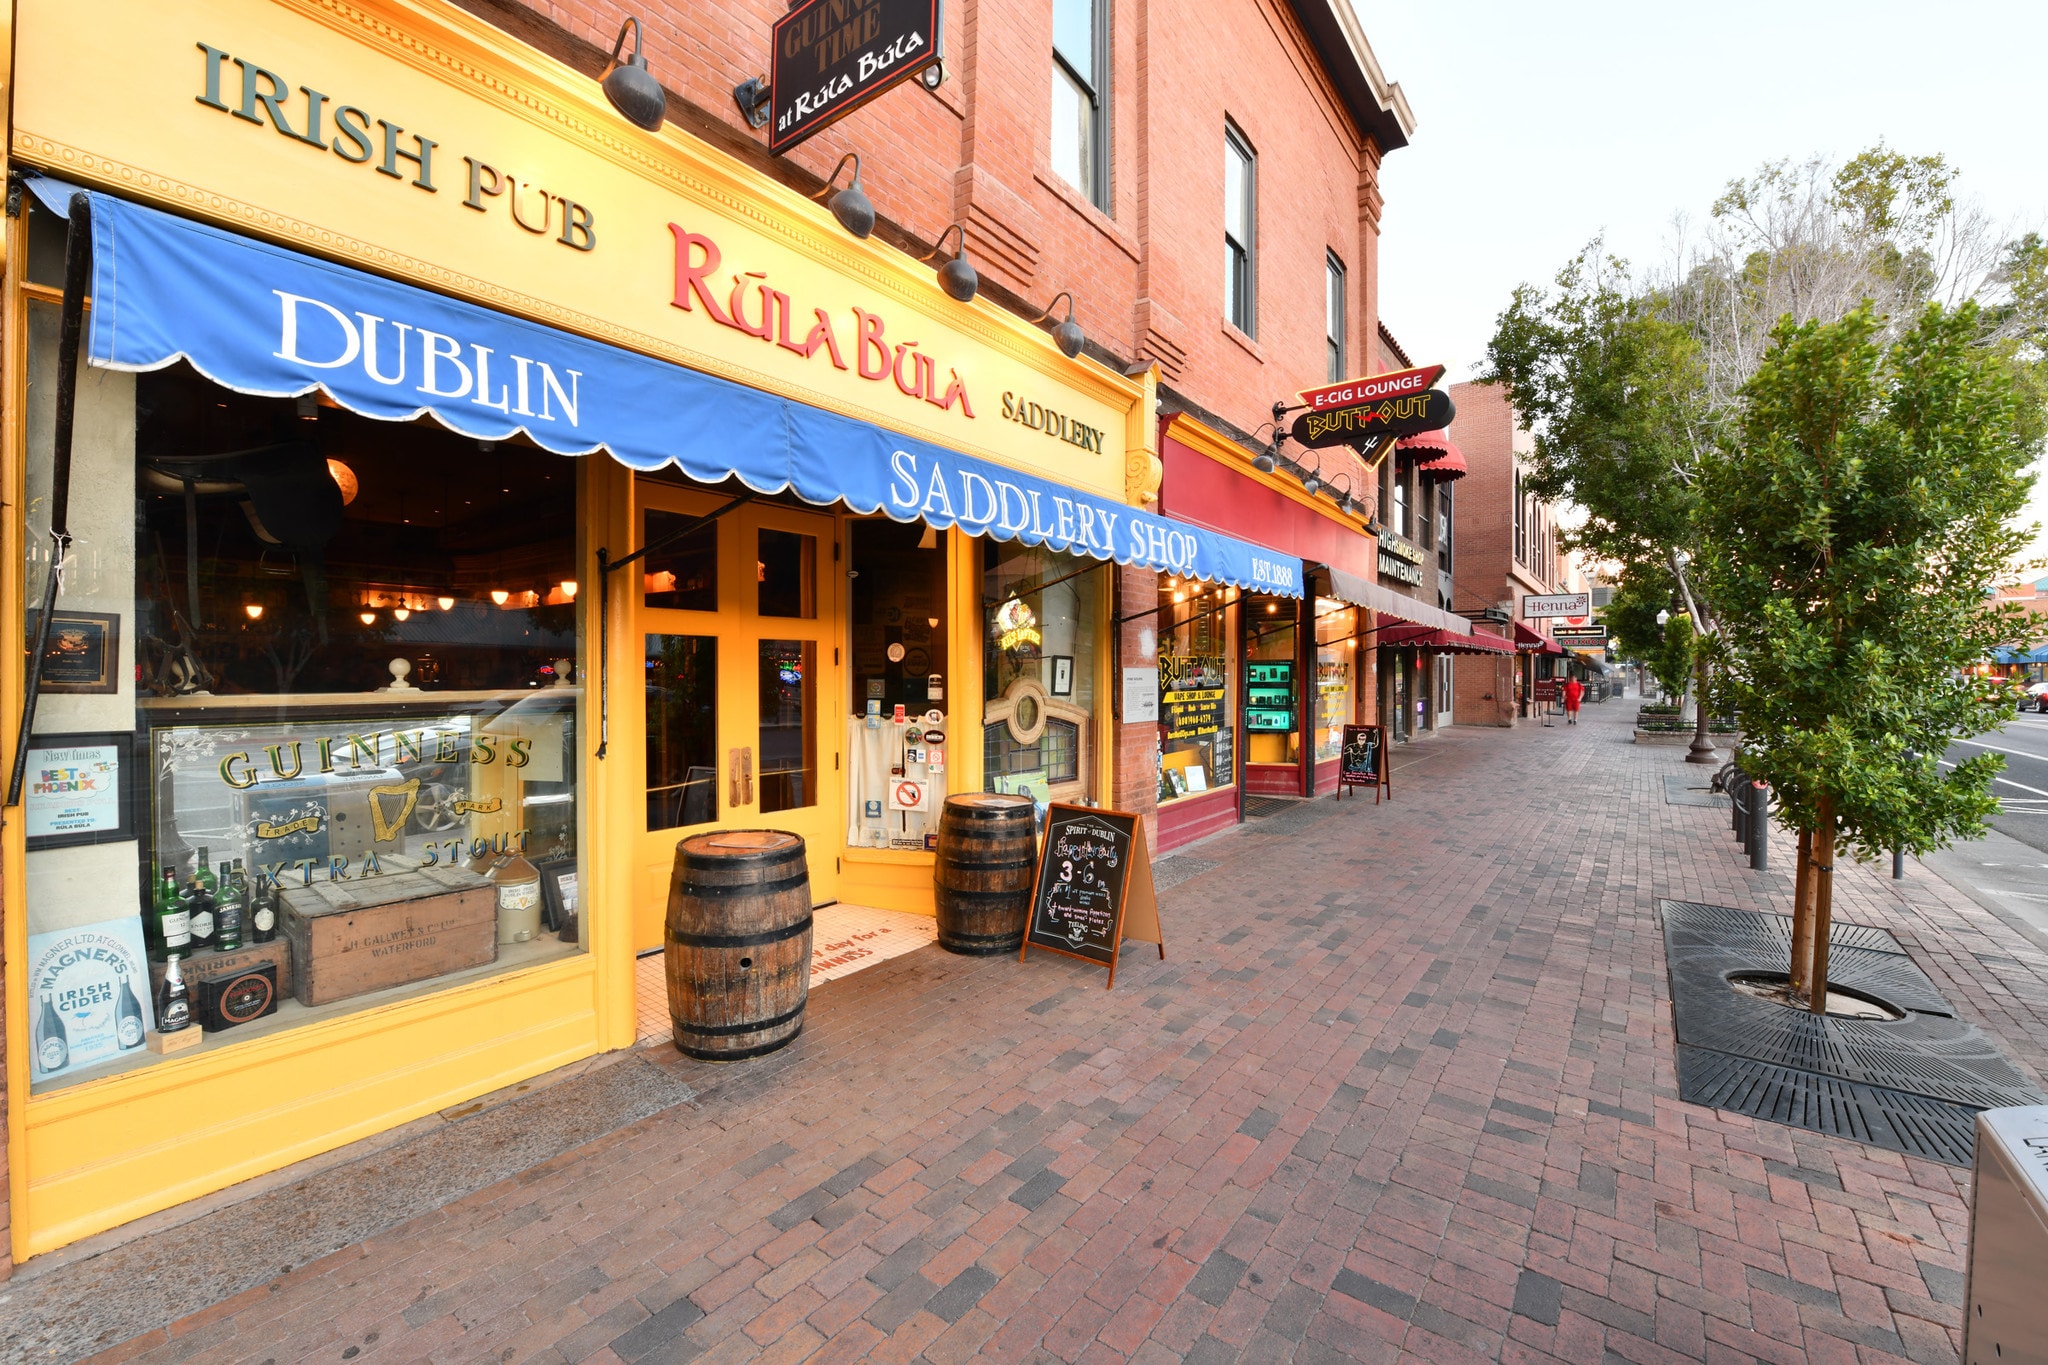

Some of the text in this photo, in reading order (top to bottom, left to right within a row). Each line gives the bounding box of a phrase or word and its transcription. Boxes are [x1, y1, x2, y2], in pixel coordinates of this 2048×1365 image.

[814, 3, 881, 74] TIME
[778, 31, 924, 132] at Rúla Búla
[195, 41, 597, 252] IRISH PUB
[271, 289, 583, 428] DUBLIN
[1315, 375, 1423, 406] E-CIG LOUNGE
[1001, 390, 1105, 455] SADDLERY
[1306, 394, 1431, 440] BUTT OUT
[890, 450, 1197, 570] SADDLERY SHOP
[1379, 529, 1396, 553] HIGH
[1379, 553, 1423, 587] MAINTENANCE
[1529, 600, 1578, 612] Henna
[1517, 641, 1540, 650] Henna
[1159, 655, 1198, 690] BUTT
[218, 730, 532, 790] GUINNESS
[33, 779, 96, 794] PHOENIX
[41, 767, 78, 783] BEST
[459, 801, 493, 811] MARK
[265, 819, 308, 836] TRADE
[1065, 825, 1088, 836] SPIRIT
[1091, 828, 1116, 843] DUBLIN
[420, 828, 532, 868] STOUT
[74, 933, 95, 945] LTD
[371, 936, 437, 958] WATERFORD
[825, 939, 855, 952] day
[851, 931, 878, 942] for
[39, 947, 128, 990] MAGNER'S
[810, 947, 874, 975] UINNESS
[59, 981, 111, 1002] IRISH
[59, 991, 112, 1012] CIDER
